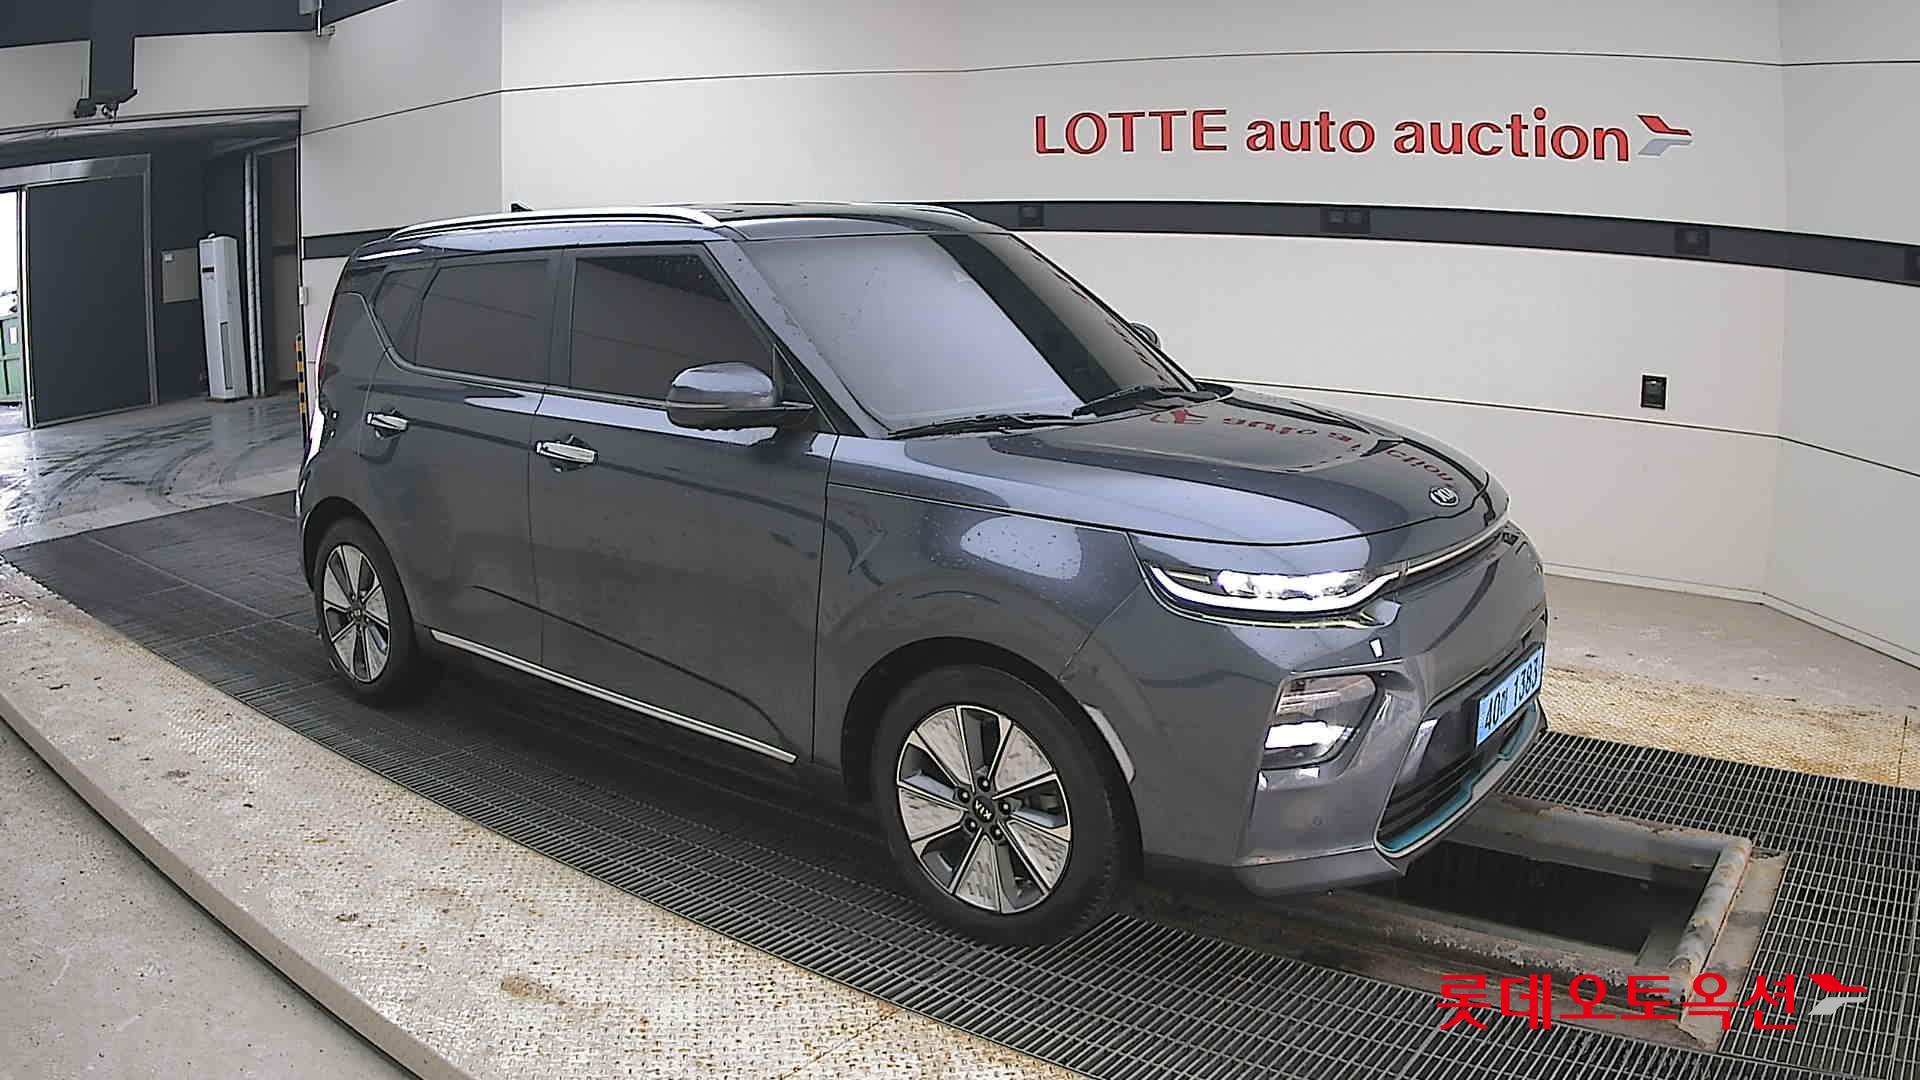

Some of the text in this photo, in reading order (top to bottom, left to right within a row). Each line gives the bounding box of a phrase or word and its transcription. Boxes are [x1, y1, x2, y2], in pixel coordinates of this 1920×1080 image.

[1034, 106, 1630, 162] LOTTE auto auction
[1514, 657, 1538, 705] 1383
